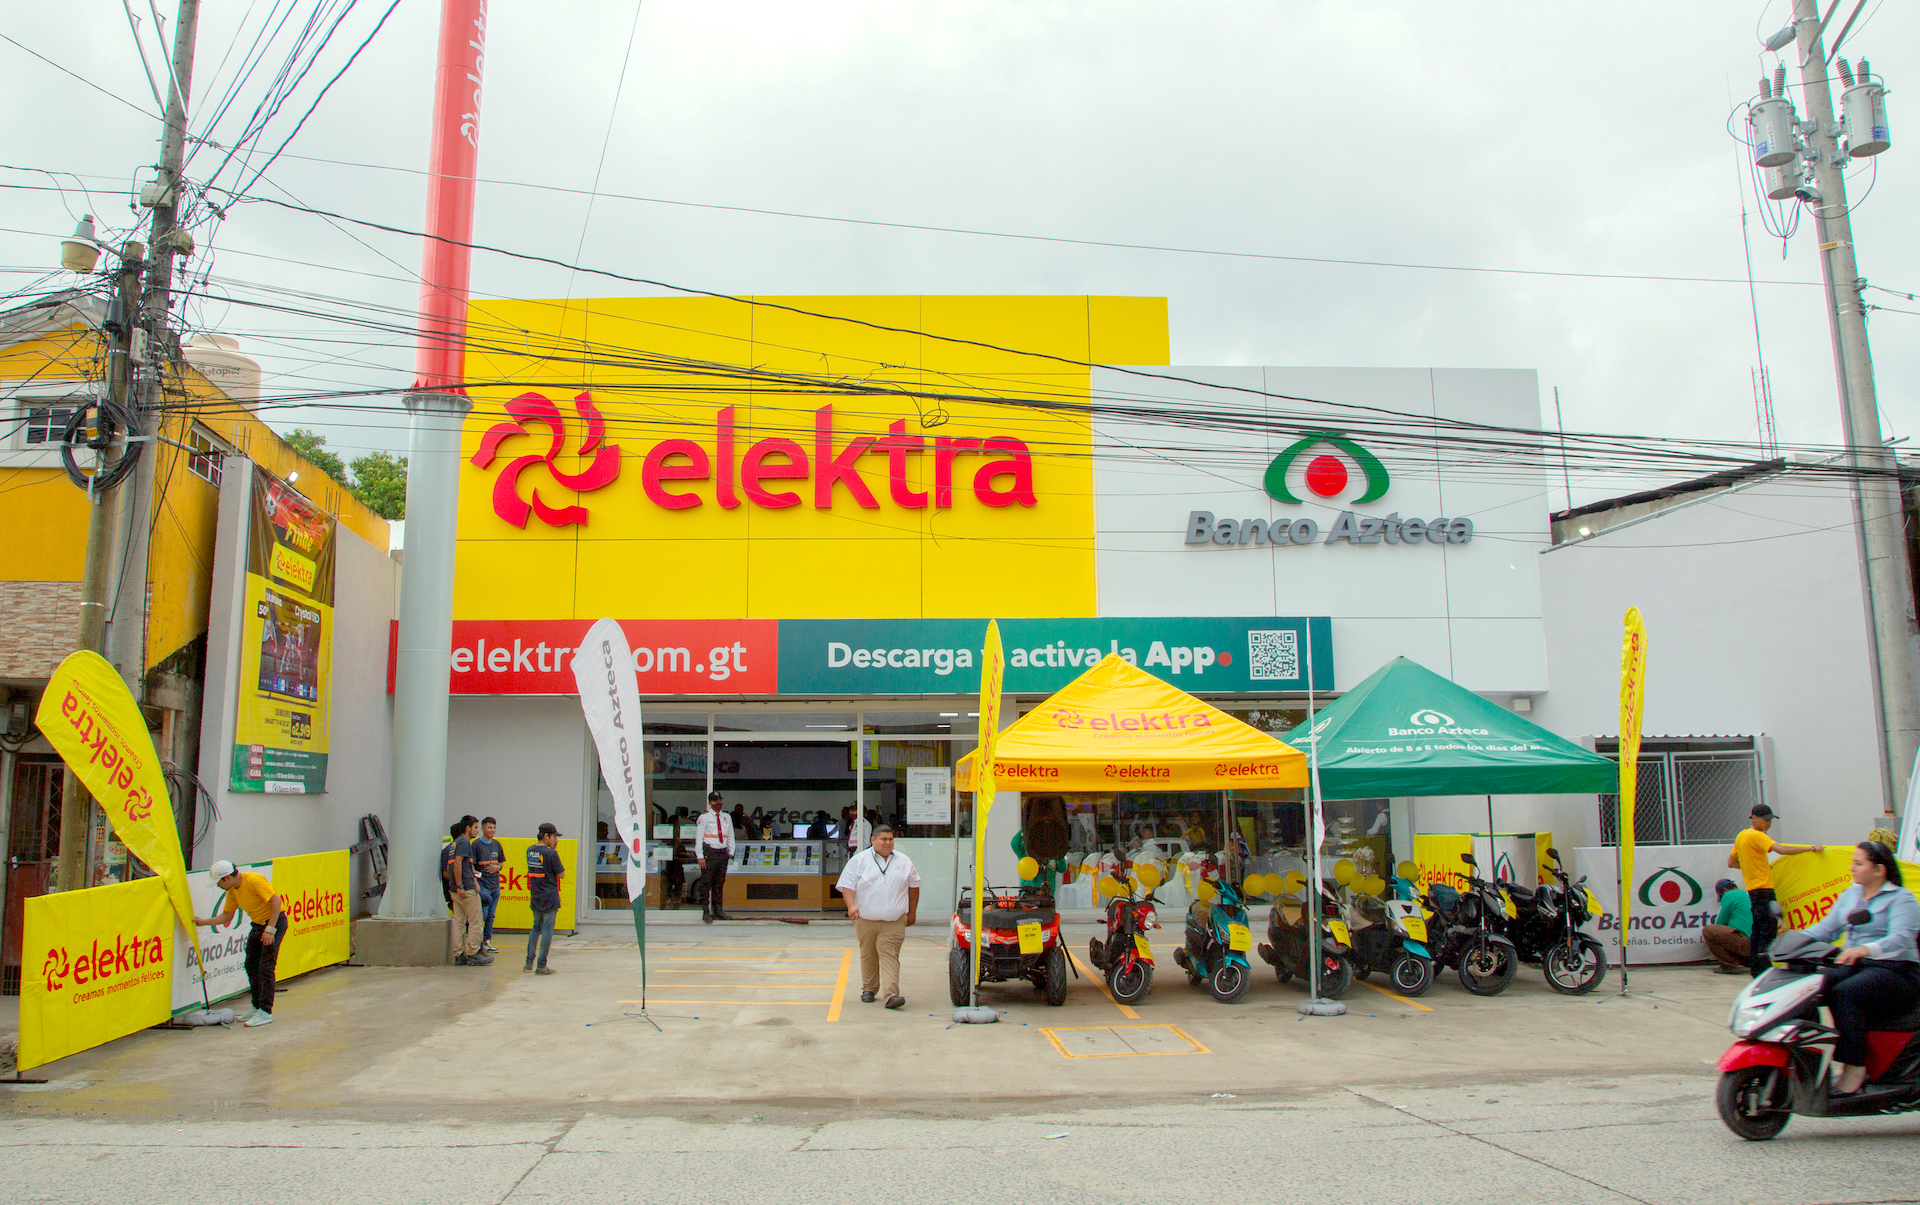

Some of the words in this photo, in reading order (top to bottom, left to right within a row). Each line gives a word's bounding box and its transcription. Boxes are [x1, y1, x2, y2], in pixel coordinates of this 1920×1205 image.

[641, 403, 1038, 510] elektra
[1184, 510, 1319, 546] Banco
[1323, 510, 1474, 546] Azteca
[285, 556, 313, 586] elektra
[450, 638, 748, 680] elektrom.gt
[827, 642, 973, 675] Descarga
[1010, 640, 1102, 667] activa
[1111, 639, 1136, 666] la
[602, 640, 624, 730] Azteca
[92, 701, 120, 740] momentos
[1089, 712, 1212, 731] elektra
[1185, 729, 1216, 737] felices
[1388, 727, 1434, 736] Banco
[1437, 726, 1489, 736] Azteca
[61, 690, 134, 790] elektra
[120, 738, 142, 770] Creamos
[619, 736, 638, 817] Banco
[1007, 763, 1059, 778] elektra
[1119, 764, 1170, 778] elektra
[1229, 763, 1279, 776] elektra
[1788, 885, 1821, 903] momentos
[1822, 874, 1851, 889] Creamos
[293, 888, 344, 922] elektra
[1612, 937, 1651, 946] Señas.
[1653, 935, 1697, 945] Decides.
[73, 933, 163, 985] elektra
[73, 988, 105, 1004] Creamos
[106, 977, 140, 994] momentos
[141, 970, 165, 984] felices
